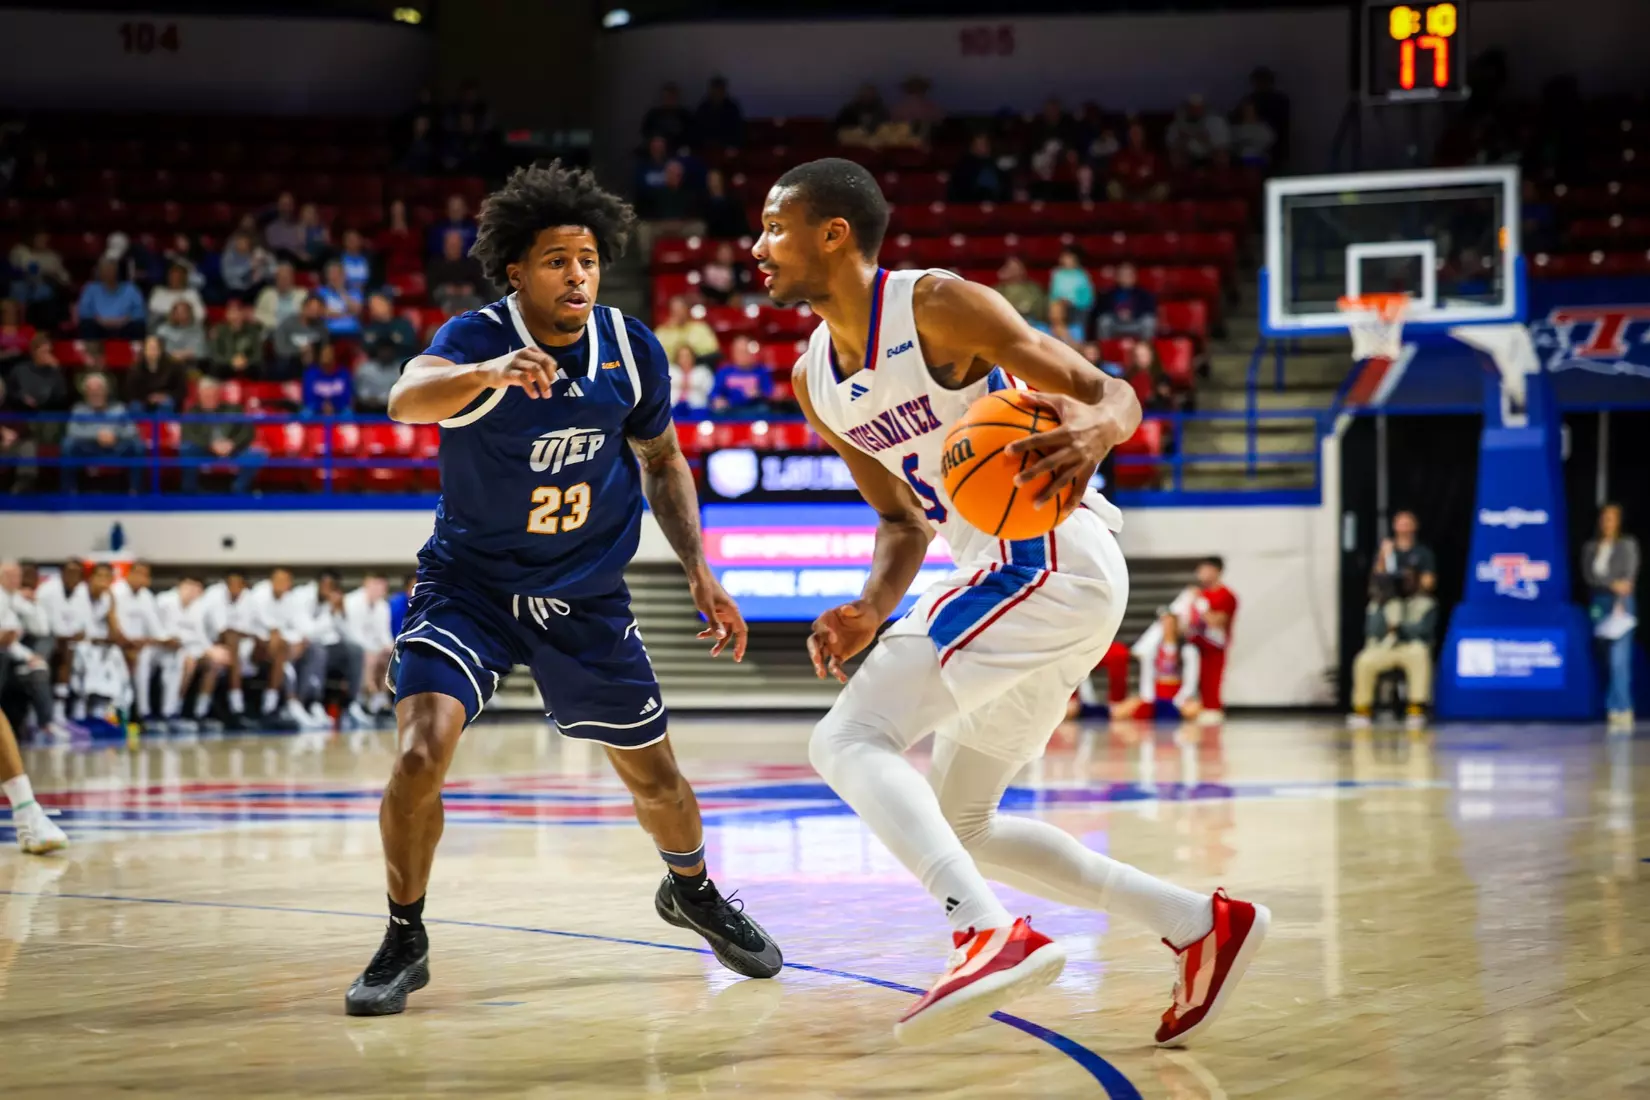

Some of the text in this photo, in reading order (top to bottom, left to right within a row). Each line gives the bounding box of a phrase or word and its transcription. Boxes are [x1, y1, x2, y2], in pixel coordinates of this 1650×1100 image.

[118, 22, 181, 55] 104
[1400, 34, 1449, 90] 17
[529, 427, 606, 475] UTEP
[526, 481, 592, 535] 23
[902, 452, 948, 524] 5
